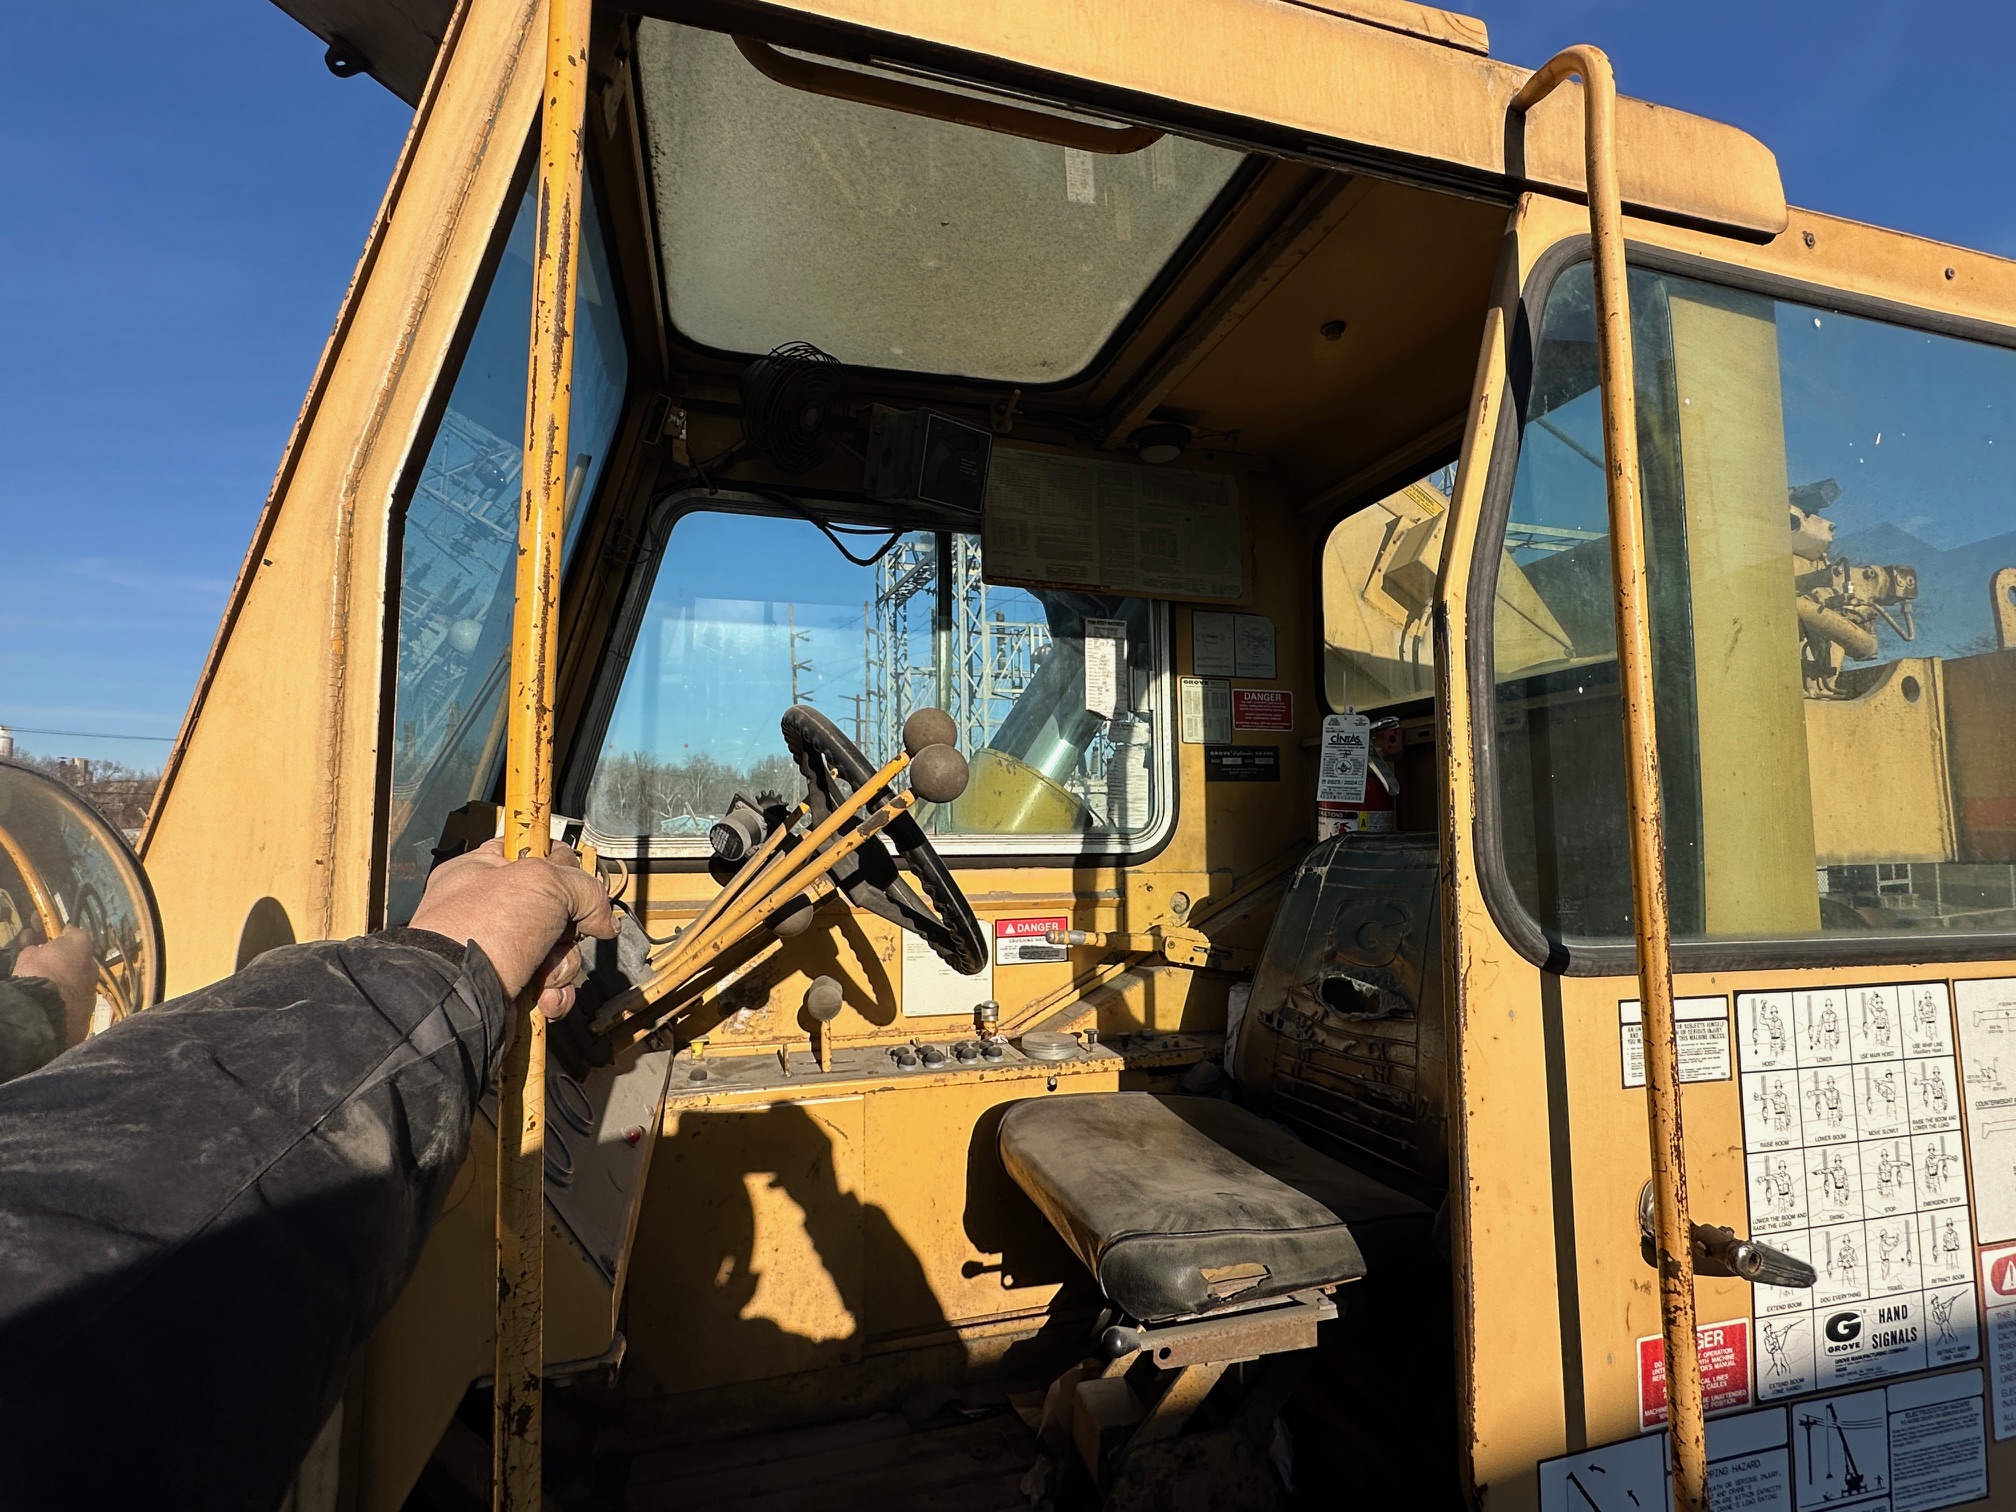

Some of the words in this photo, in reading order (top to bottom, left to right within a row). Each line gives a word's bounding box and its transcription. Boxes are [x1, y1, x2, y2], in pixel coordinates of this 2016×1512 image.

[1244, 692, 1281, 701] DANGER
[1330, 733, 1362, 743] CINTAS
[1361, 819, 1366, 827] A
[1017, 923, 1059, 932] DANGER
[1975, 1098, 2012, 1106] COUNTERWEIGHT
[1832, 1291, 1861, 1302] EVERYTHING
[1766, 1304, 1786, 1312] EXTEND
[1788, 1301, 1802, 1309] BOOM
[1878, 1305, 1908, 1323] HAND
[1826, 1312, 1861, 1342] G
[1872, 1327, 1917, 1349] SIGNALS
[1703, 1348, 1733, 1357] OPERATION
[1828, 1342, 1860, 1353] GROVE
[1937, 1348, 1957, 1356] RETRACT
[1711, 1354, 1735, 1363] MACHINE
[1714, 1361, 1736, 1369] MANUAL
[1713, 1374, 1728, 1382] LINES
[1708, 1381, 1727, 1390] CABLES
[1769, 1381, 1788, 1390] EXTEND
[1790, 1378, 1805, 1387] BOOM
[1712, 1390, 1746, 1401] UNATTENDED
[1732, 1459, 1760, 1473] HAZARD
[1710, 1484, 1723, 1492] EATH
[1735, 1475, 1757, 1486] SERIOUS
[1729, 1485, 1752, 1496] CRANE'S
[1735, 1491, 1754, 1500] WITHIN
[1757, 1485, 1782, 1495] CAPACITY
[1742, 1498, 1756, 1507] LOAD
[1758, 1493, 1777, 1503] RATING
